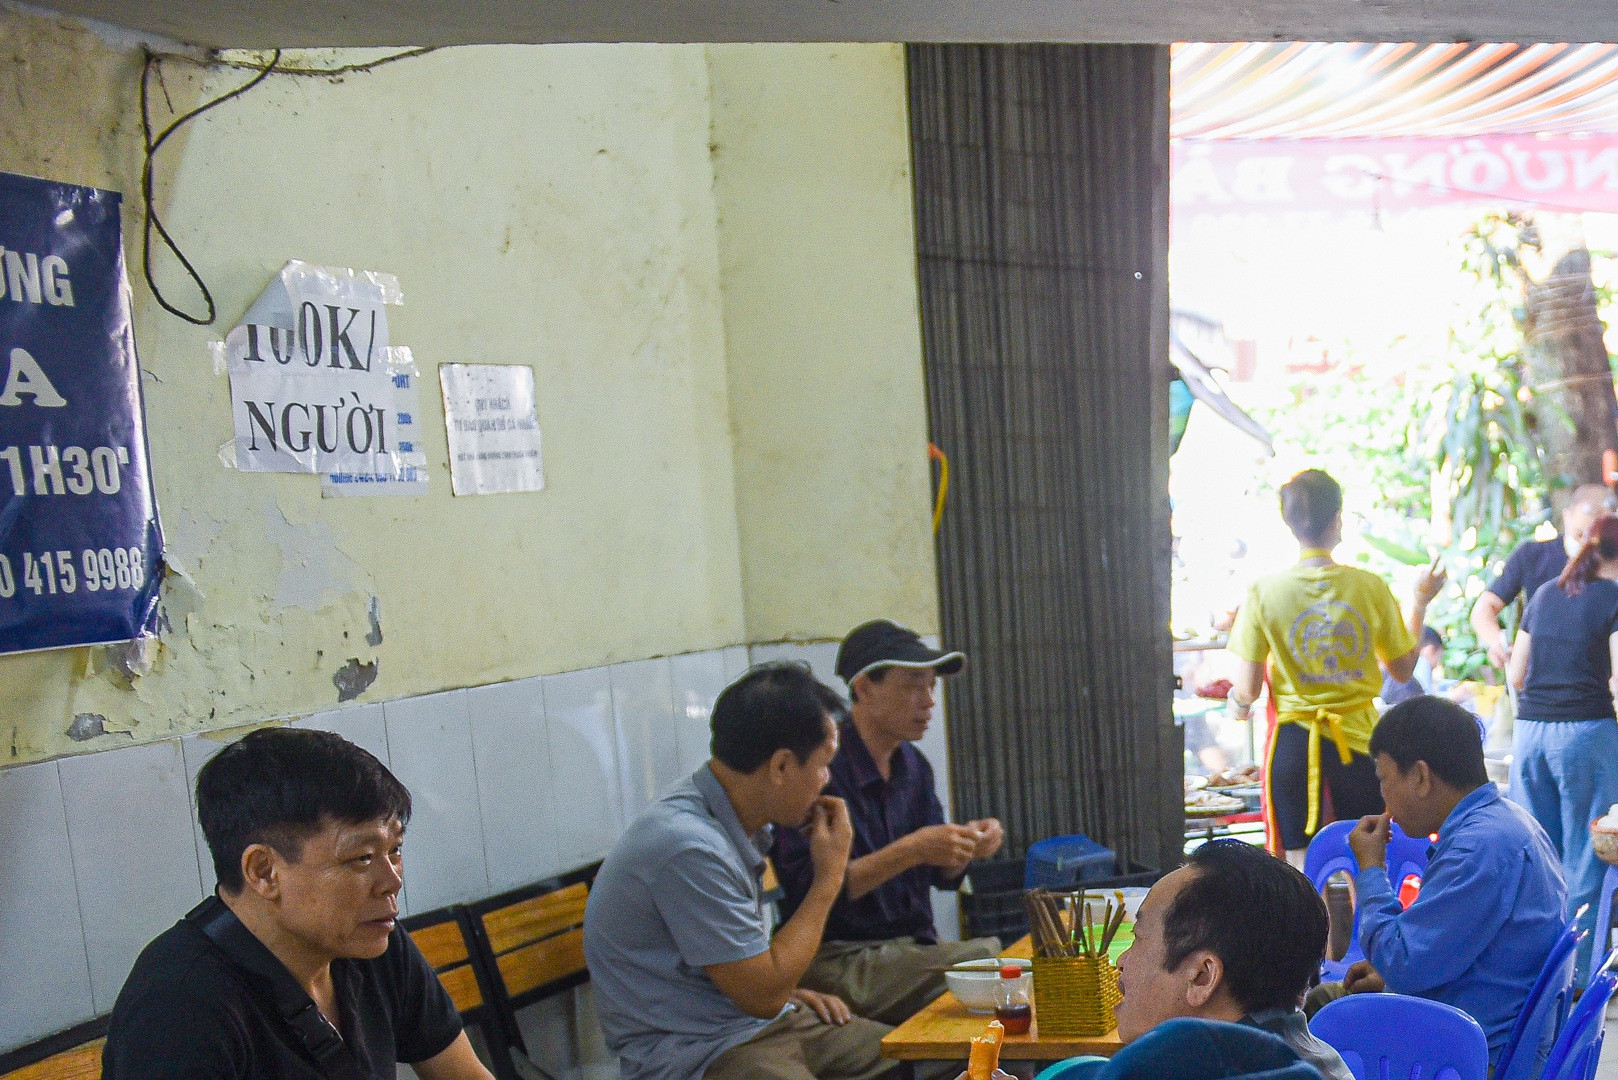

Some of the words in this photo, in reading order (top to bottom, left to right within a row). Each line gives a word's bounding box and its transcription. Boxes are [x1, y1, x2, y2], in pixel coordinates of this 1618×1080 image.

[243, 391, 388, 454] NGƯỜI
[23, 551, 76, 595] 415
[82, 547, 144, 591] 9988
